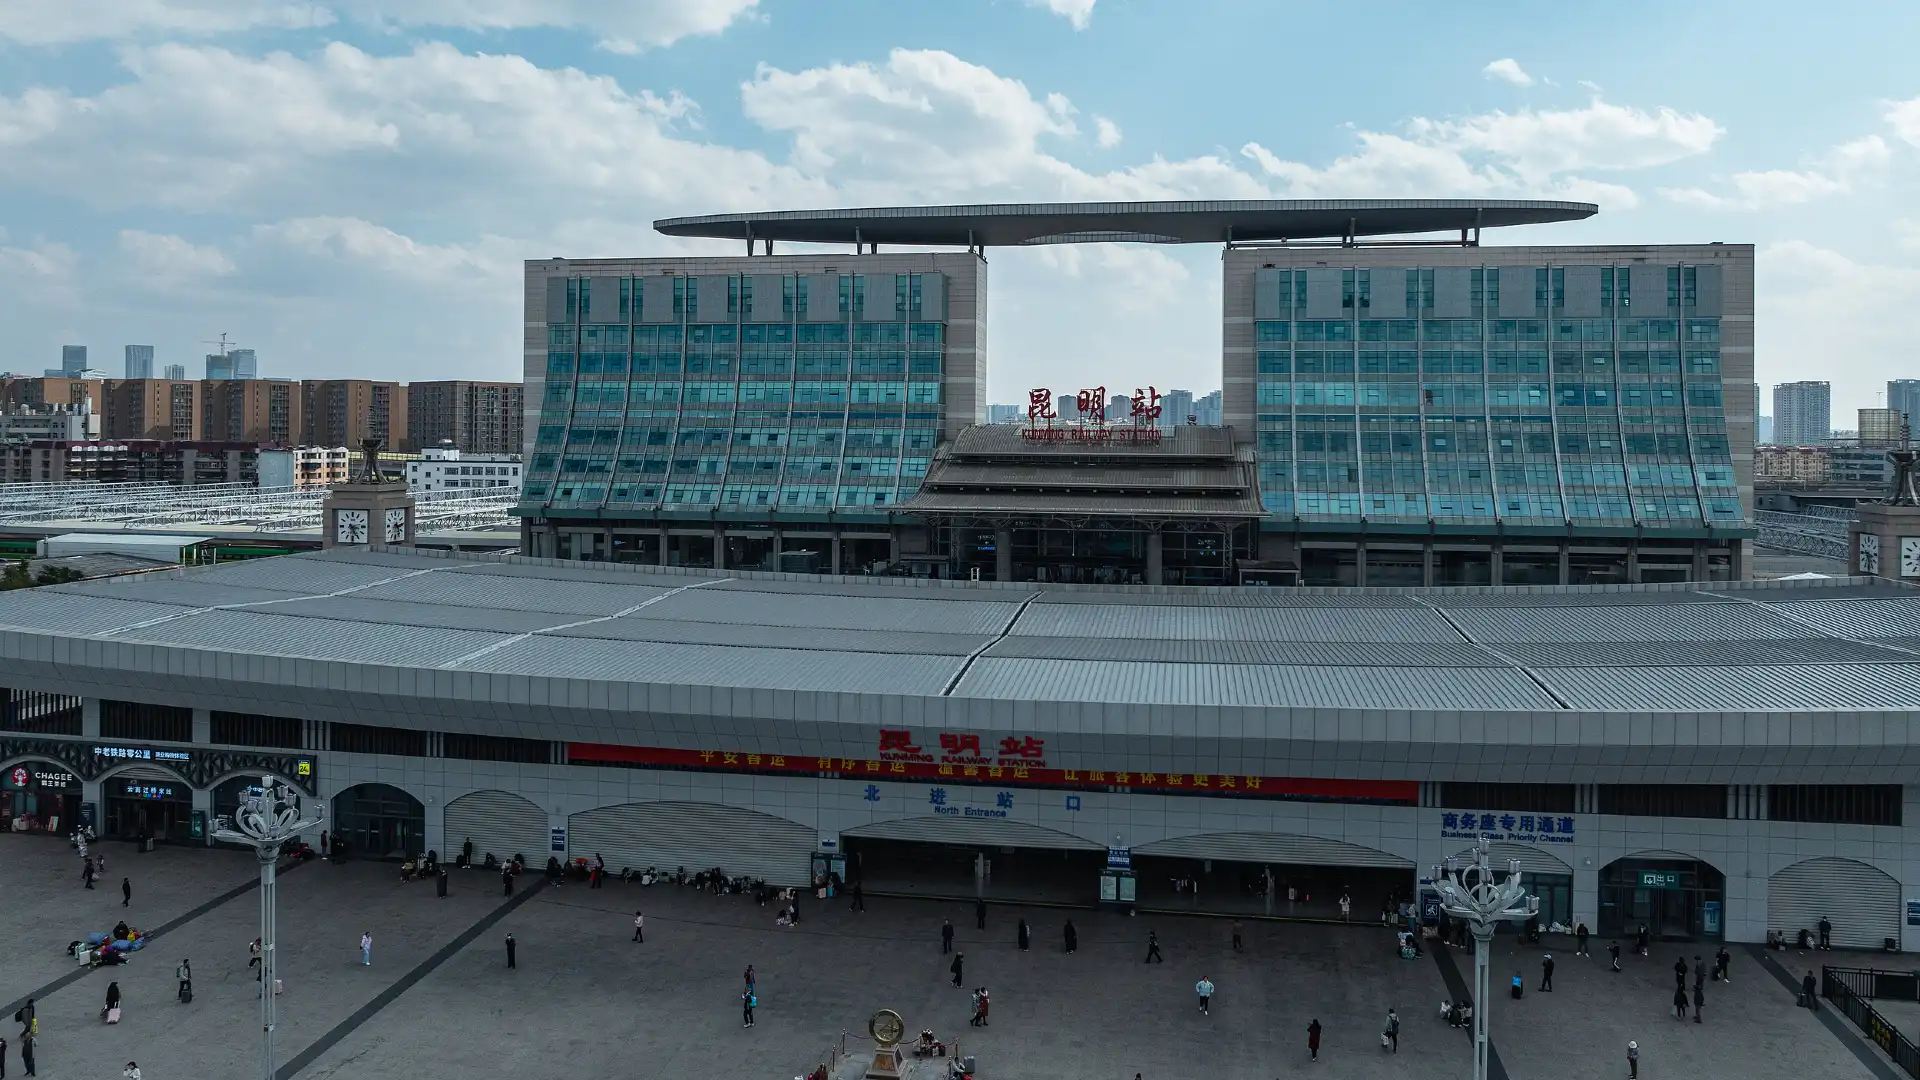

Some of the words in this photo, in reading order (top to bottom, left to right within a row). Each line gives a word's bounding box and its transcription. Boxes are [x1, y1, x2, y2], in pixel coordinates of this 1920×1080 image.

[1029, 386, 1163, 421] 昆明站
[1022, 429, 1064, 440] KUNMING
[1071, 429, 1113, 440] RAILWAY
[1120, 430, 1162, 440] STATION
[879, 729, 1045, 758] 昆明站
[94, 747, 151, 760] 中老铁路零公里
[880, 752, 934, 763] KUNMING
[941, 755, 993, 765] RAILWAY
[998, 758, 1046, 767] STATION
[700, 750, 785, 766] 平安春运
[818, 757, 906, 773] 有序春运
[938, 764, 1029, 778] 温馨春运
[1064, 770, 1264, 789] 让旅客体验更美好
[35, 772, 73, 781] CHAGEE
[127, 785, 172, 796] 云南过桥米线
[864, 784, 1081, 811] 北进站口
[934, 806, 959, 816] North
[965, 807, 1007, 818] Entrance
[1441, 812, 1575, 833] 商务座专用通道
[1441, 830, 1477, 839] Business
[1481, 832, 1504, 840] Class
[1508, 833, 1538, 843] Priority
[1540, 834, 1573, 843] Channel
[1656, 874, 1675, 883] 出口
